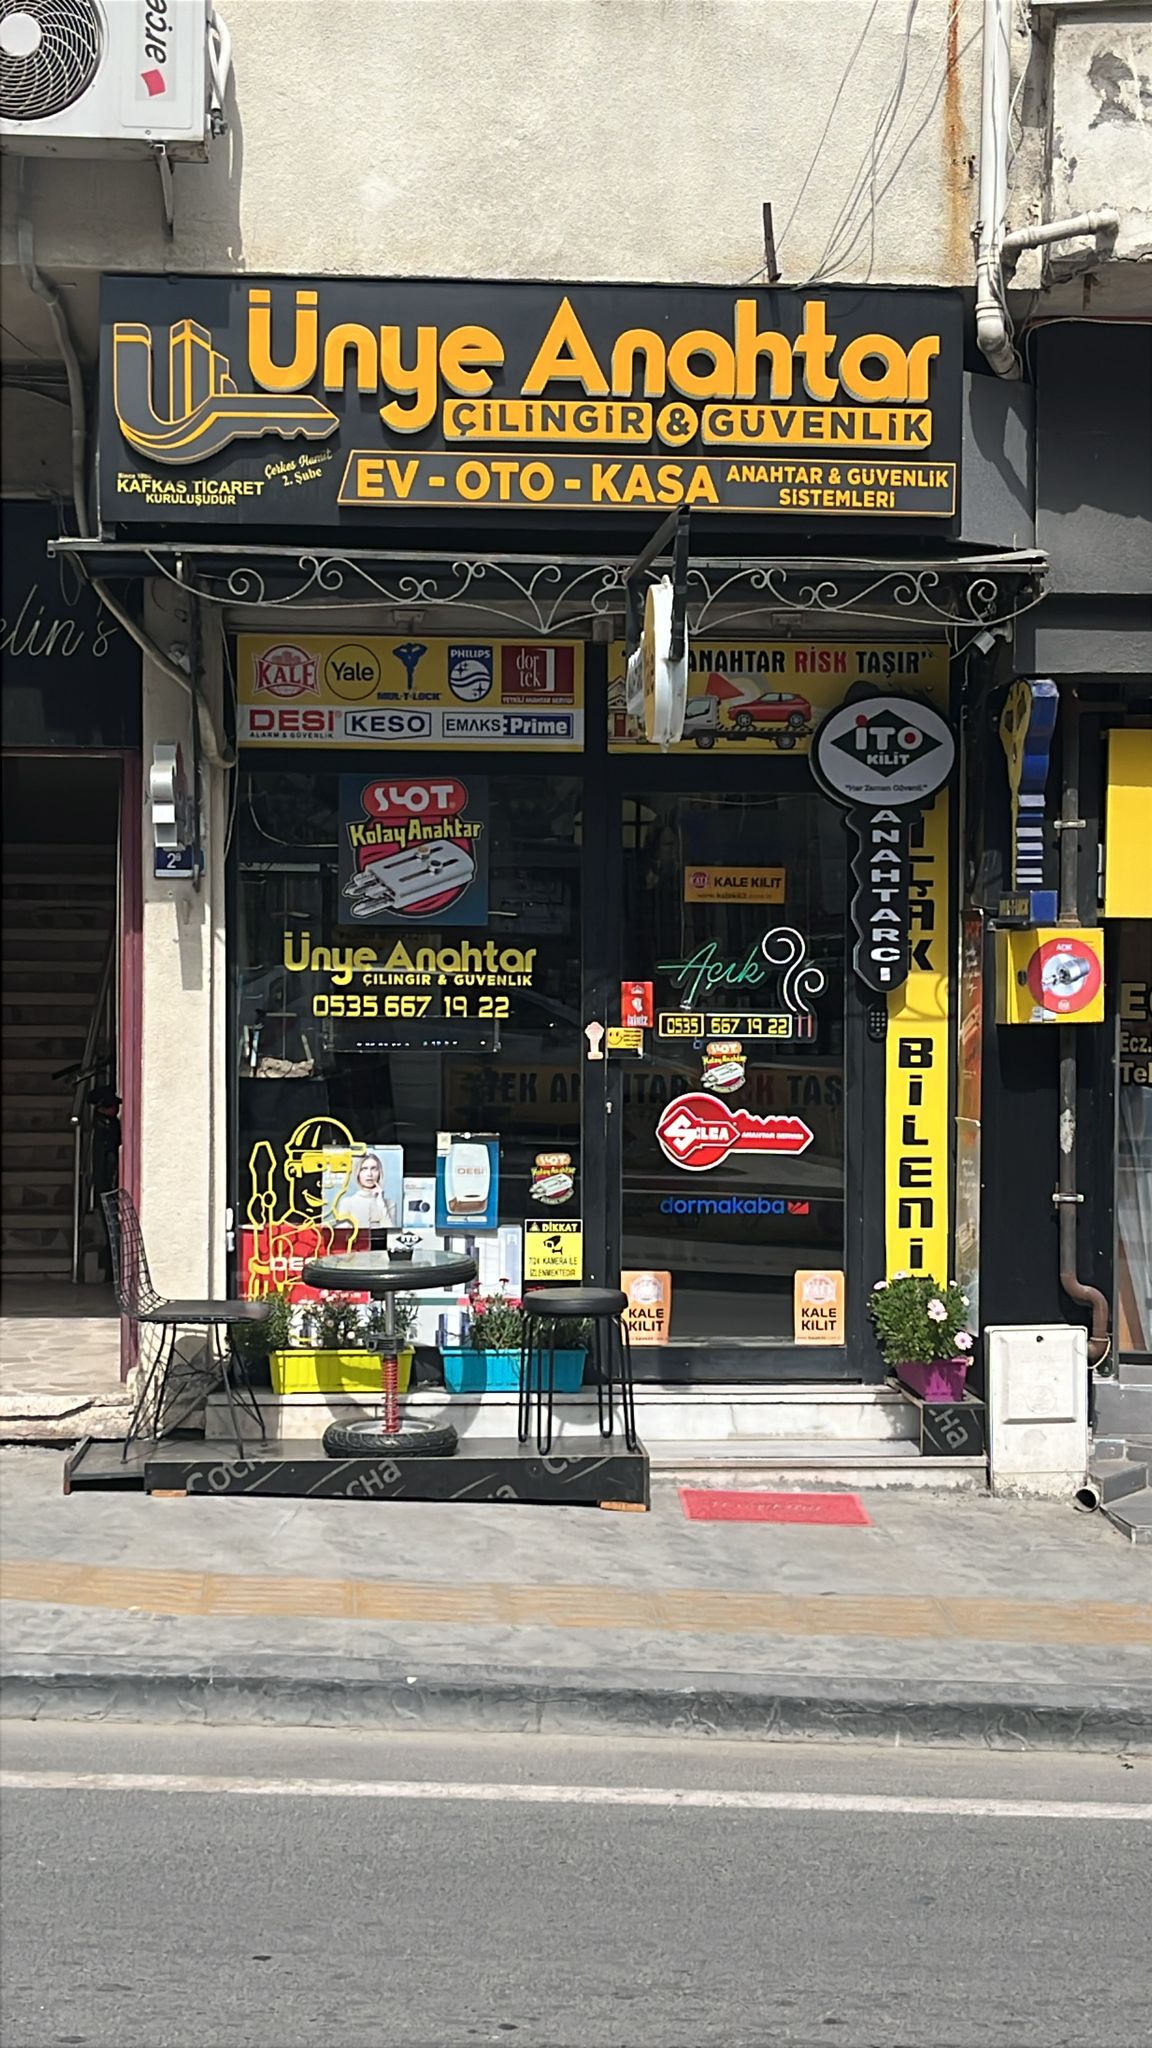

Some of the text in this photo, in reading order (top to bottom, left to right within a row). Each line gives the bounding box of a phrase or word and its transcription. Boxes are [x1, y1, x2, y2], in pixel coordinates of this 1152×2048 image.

[249, 289, 940, 434] Ünye Anahtar
[452, 403, 928, 442] ÇİLİNGİR & GÜVENLİK
[357, 459, 419, 499] EV
[456, 460, 554, 501] OTO
[591, 463, 719, 504] KASA
[726, 465, 949, 488] ANAHTAR & GÜVENLİK
[117, 478, 264, 495] KAFKAS TİCARET
[146, 493, 236, 506] KURULUŞUDUR
[779, 489, 895, 509] SİSTEMLERİ
[450, 649, 491, 658] PHILIPS
[795, 645, 847, 673] RİSK
[256, 659, 316, 690] KALE
[331, 661, 374, 681] Yale
[250, 709, 334, 731] DESI
[351, 715, 426, 733] KESO
[510, 718, 568, 734] Prime
[867, 752, 910, 765] KİLİT
[374, 785, 455, 812] SLOT
[349, 818, 481, 848] Kolay Anahtar
[714, 876, 748, 888] KALE
[870, 810, 902, 981] ANAHTARCI
[284, 932, 537, 985] Ünye Anahtar
[438, 974, 447, 986] &
[313, 995, 509, 1018] 0535 667 19 22
[667, 1018, 787, 1034] 0535 667 19 22
[660, 1196, 784, 1214] dormakaba
[542, 1221, 578, 1232] DİKKAT
[629, 1308, 664, 1318] KALE
[802, 1308, 836, 1318] KALE
[629, 1320, 664, 1332] KILIT
[802, 1320, 836, 1331] KILIT
